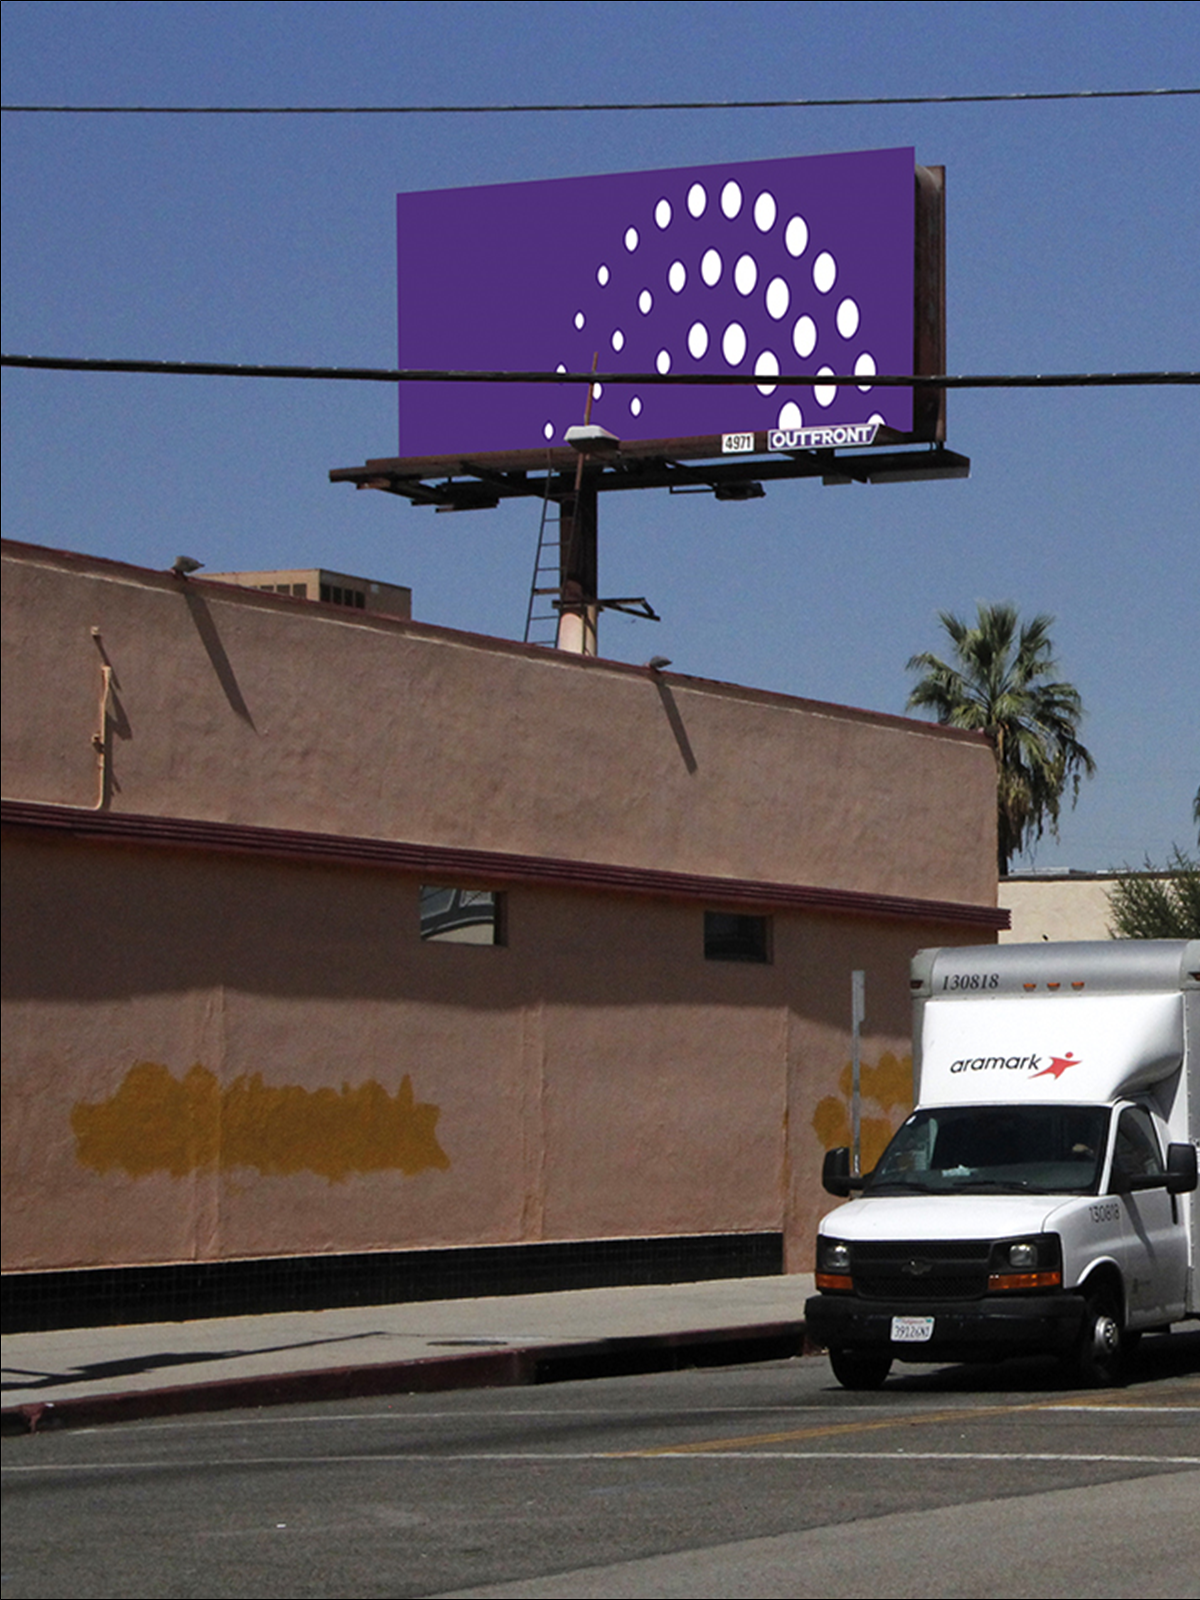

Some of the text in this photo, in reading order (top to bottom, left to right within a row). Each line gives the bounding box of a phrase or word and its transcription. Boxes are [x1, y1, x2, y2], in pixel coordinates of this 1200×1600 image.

[724, 433, 752, 450] 4971
[771, 426, 874, 448] OUTFRONT
[942, 973, 1000, 991] 130818
[949, 1053, 1043, 1074] aramark
[1088, 1203, 1120, 1224] 130818
